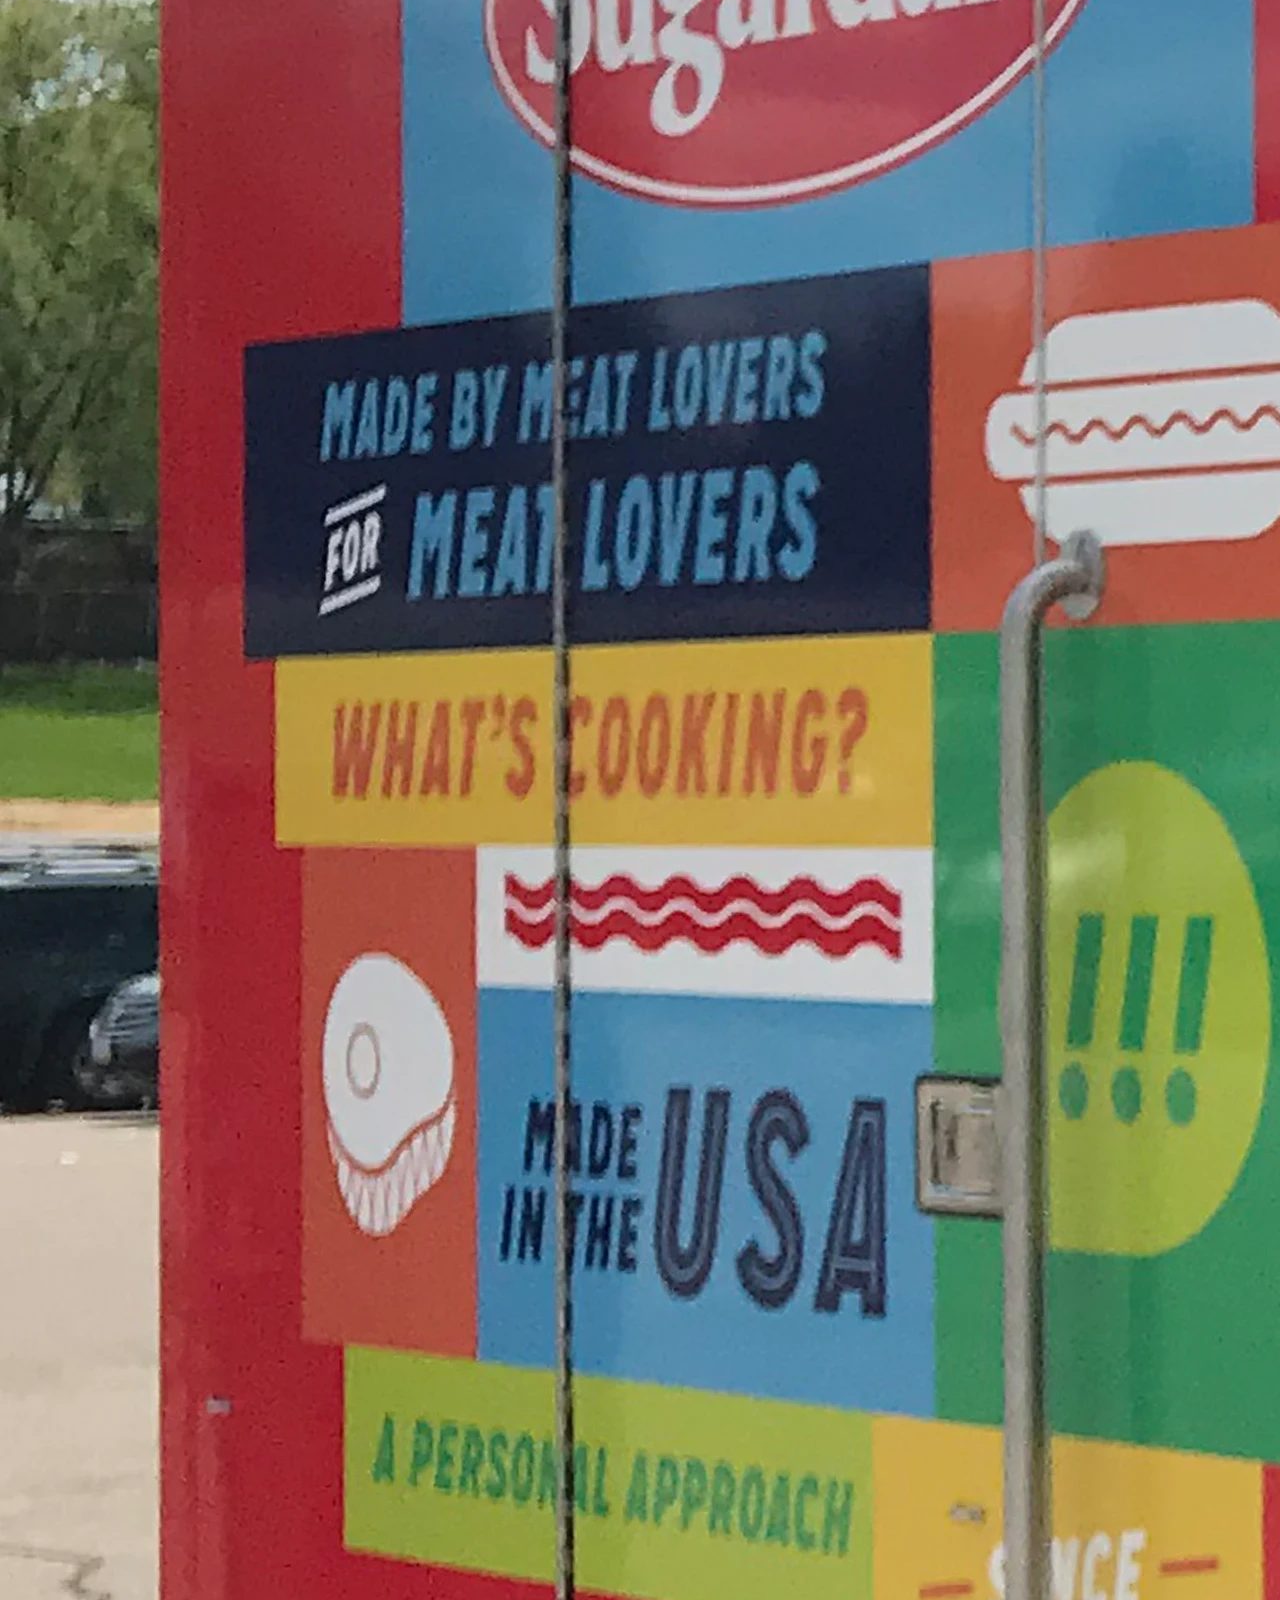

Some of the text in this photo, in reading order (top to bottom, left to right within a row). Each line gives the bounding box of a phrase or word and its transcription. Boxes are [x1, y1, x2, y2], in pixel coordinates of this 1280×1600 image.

[319, 374, 438, 462] MADE
[451, 365, 507, 450] BY
[648, 329, 828, 434] LOVERS
[324, 460, 822, 602] FOR MEAT LOVERS
[331, 686, 870, 803] WHAT'S COOKING?
[499, 1185, 643, 1277] IN THE
[523, 1084, 890, 1319] MADE USA
[372, 1411, 855, 1558] A PERSONAL APPROACH
